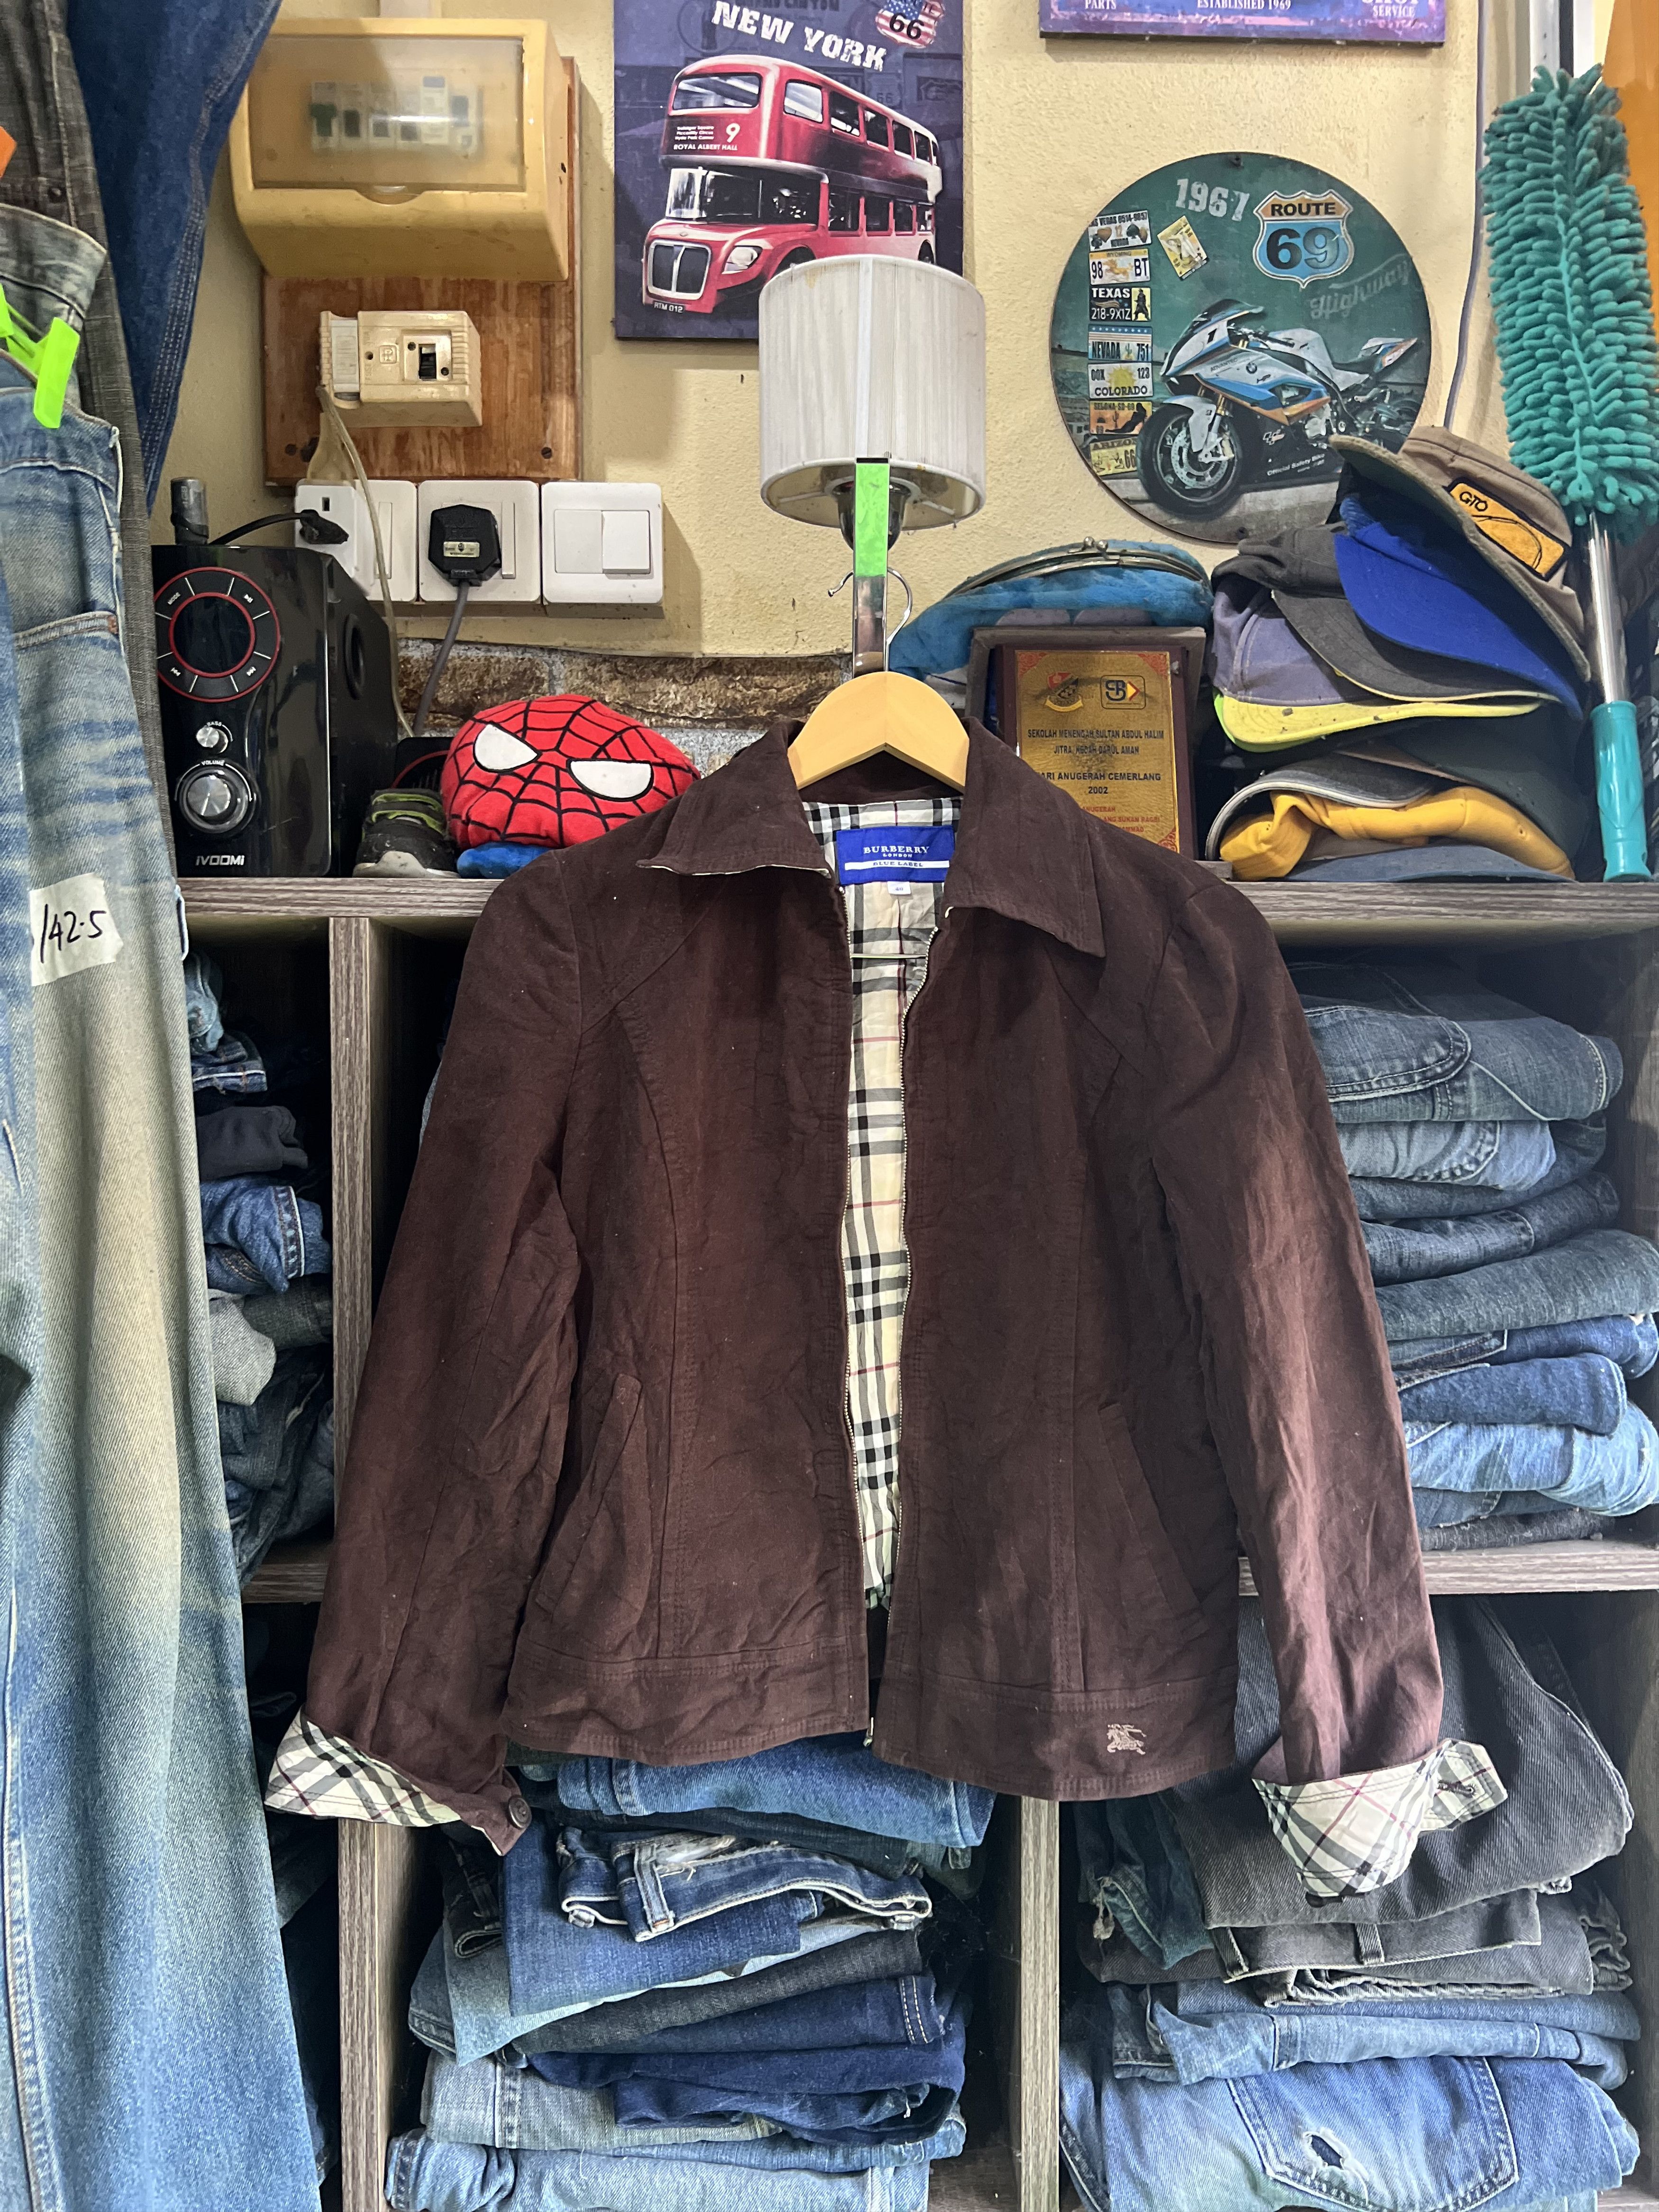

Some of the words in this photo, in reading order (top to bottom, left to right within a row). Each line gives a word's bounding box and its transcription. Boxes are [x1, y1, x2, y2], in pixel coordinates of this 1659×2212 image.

[1373, 4, 1415, 18] SERVICE
[889, 12, 924, 39] 66
[711, 0, 794, 44] NEW
[804, 27, 887, 72] YORK
[726, 123, 740, 143] 9
[1176, 178, 1250, 222] 1967
[1271, 202, 1336, 216] ROUTE
[1267, 227, 1340, 269] 69
[1092, 261, 1103, 279] 98
[1134, 258, 1148, 276] BT
[1092, 288, 1130, 298] TEXAS
[1310, 258, 1413, 319] Highway
[654, 302, 667, 310] RTM
[669, 305, 683, 313] 012
[1092, 341, 1121, 359] NEVADA
[1137, 343, 1149, 362] 751
[1138, 367, 1150, 379] 123
[1094, 385, 1148, 396] COLORADO
[1459, 491, 1488, 511] GTO
[1028, 729, 1057, 737] SEKOLAH
[1121, 730, 1142, 738] ABDUL
[1144, 730, 1164, 739] HALIM
[1099, 745, 1119, 754] DARUL
[1121, 746, 1139, 755] AMAN
[863, 846, 929, 854] BURBERRY
